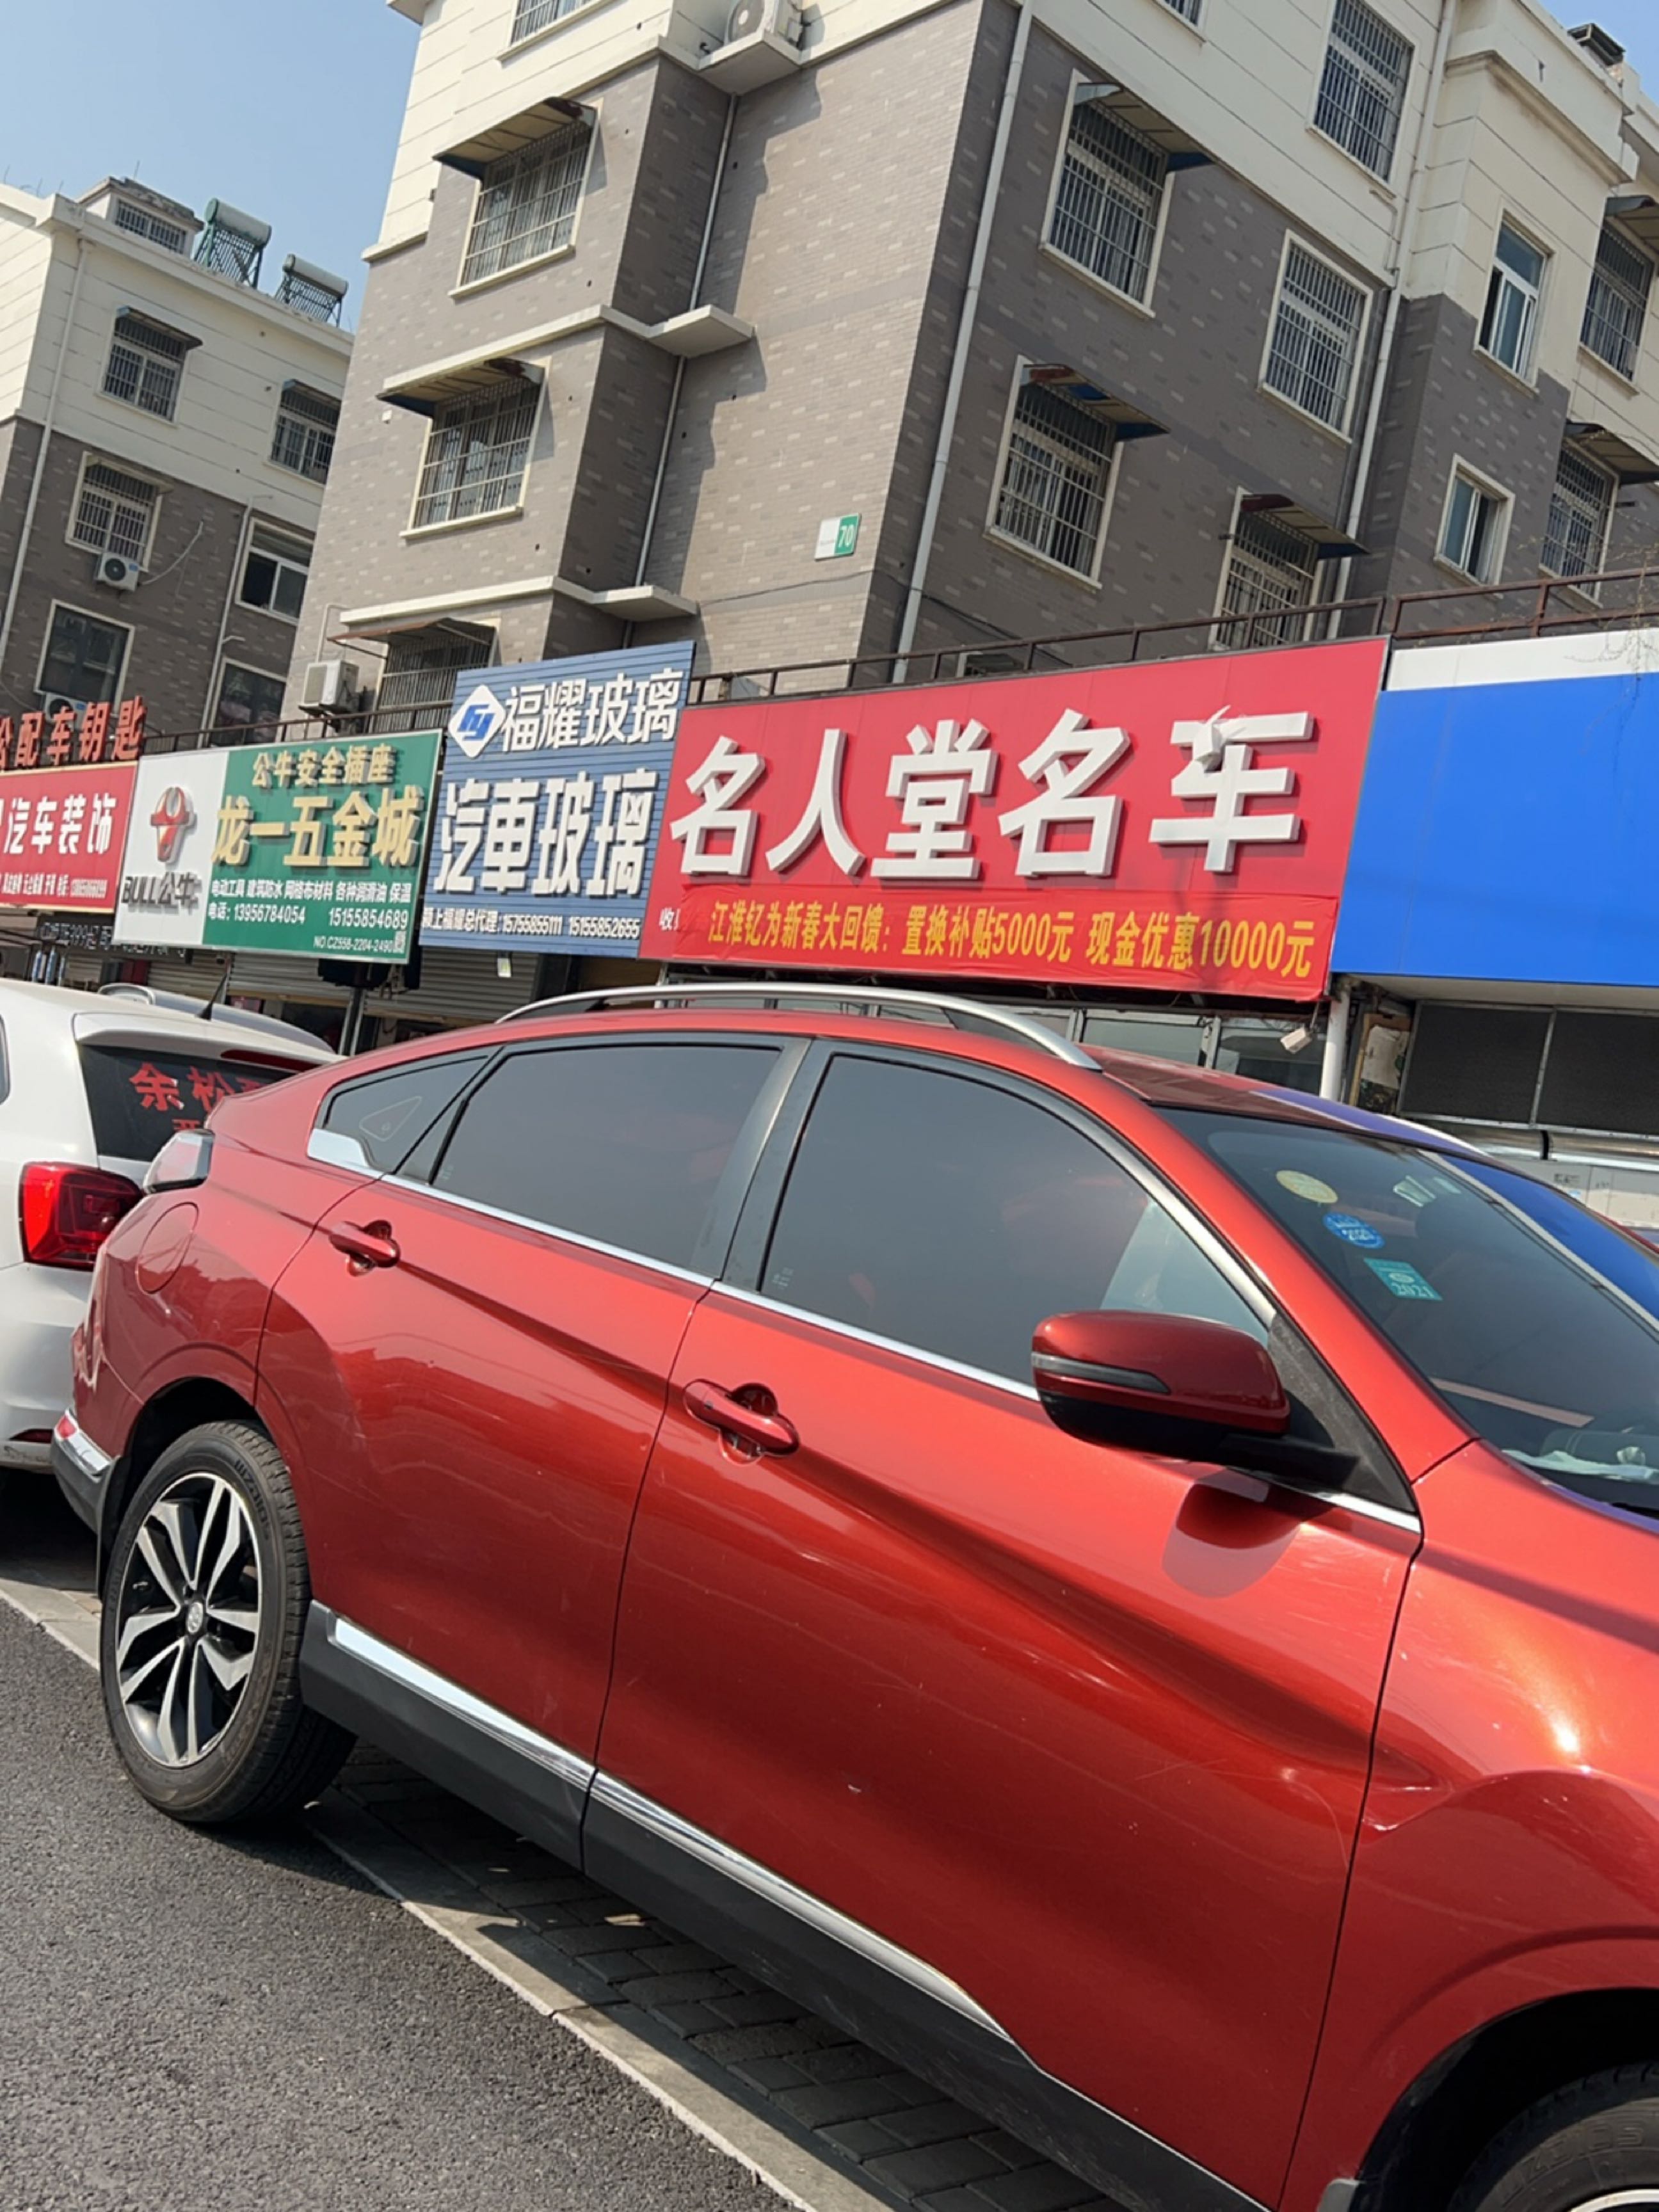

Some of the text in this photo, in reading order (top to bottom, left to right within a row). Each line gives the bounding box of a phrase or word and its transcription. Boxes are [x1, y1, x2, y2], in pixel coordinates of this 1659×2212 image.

[501, 668, 683, 751] 福耀玻璃
[252, 742, 397, 788] 公牛安全插座
[669, 709, 1313, 879] 名人堂名车
[211, 785, 424, 867] 龙一五金城
[434, 769, 658, 895] 汽車玻璃
[328, 907, 409, 930] 15155854689
[901, 904, 1074, 963] 置换补贴5000元
[1086, 911, 1314, 977] 现金优惠10000元
